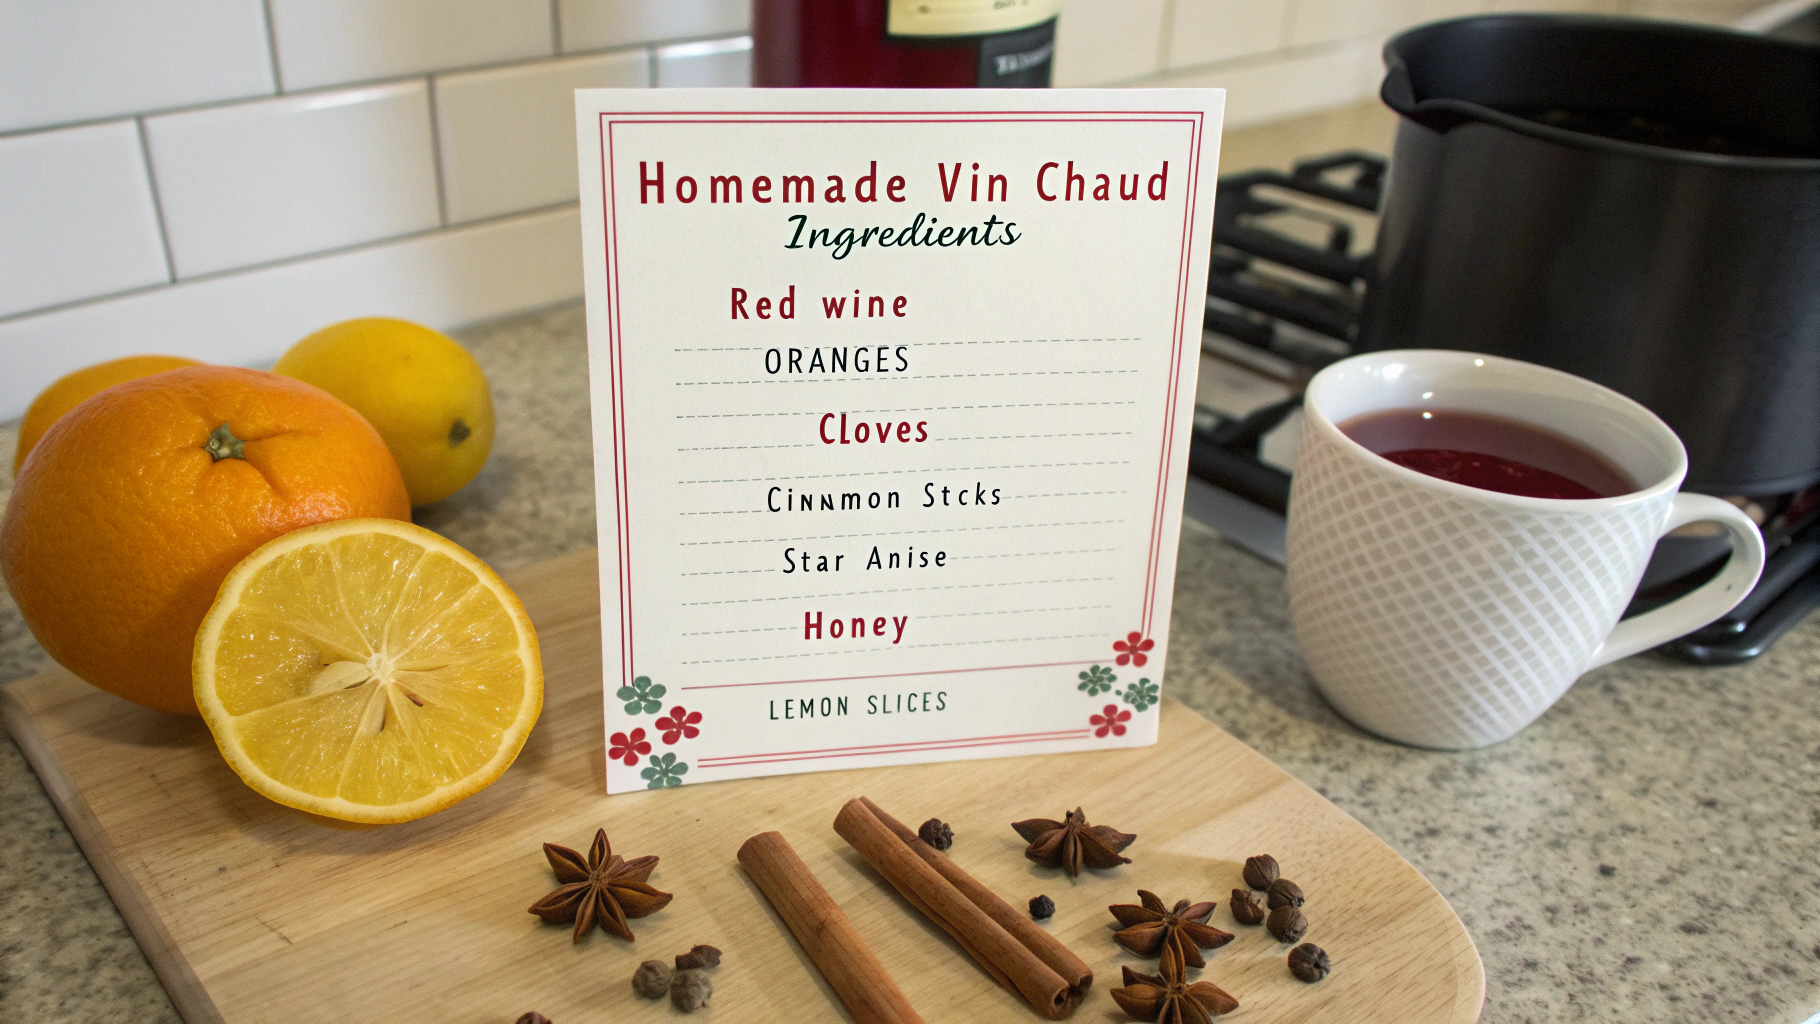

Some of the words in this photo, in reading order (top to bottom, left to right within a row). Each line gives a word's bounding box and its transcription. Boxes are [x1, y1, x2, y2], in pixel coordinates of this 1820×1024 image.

[640, 161, 905, 204] Homemade
[938, 163, 1007, 202] Vin
[1037, 161, 1168, 201] Chaud
[785, 213, 1021, 260] Ingredients
[732, 285, 795, 319] Red
[822, 289, 907, 318] wine
[765, 347, 907, 374] ORANGES
[820, 413, 927, 444] Cloves
[923, 482, 1000, 507] Stcks
[783, 548, 844, 573] Star
[867, 546, 946, 570] Anise
[805, 612, 907, 644] Honey
[770, 697, 847, 720] LEMON
[868, 692, 946, 714] SLICES
